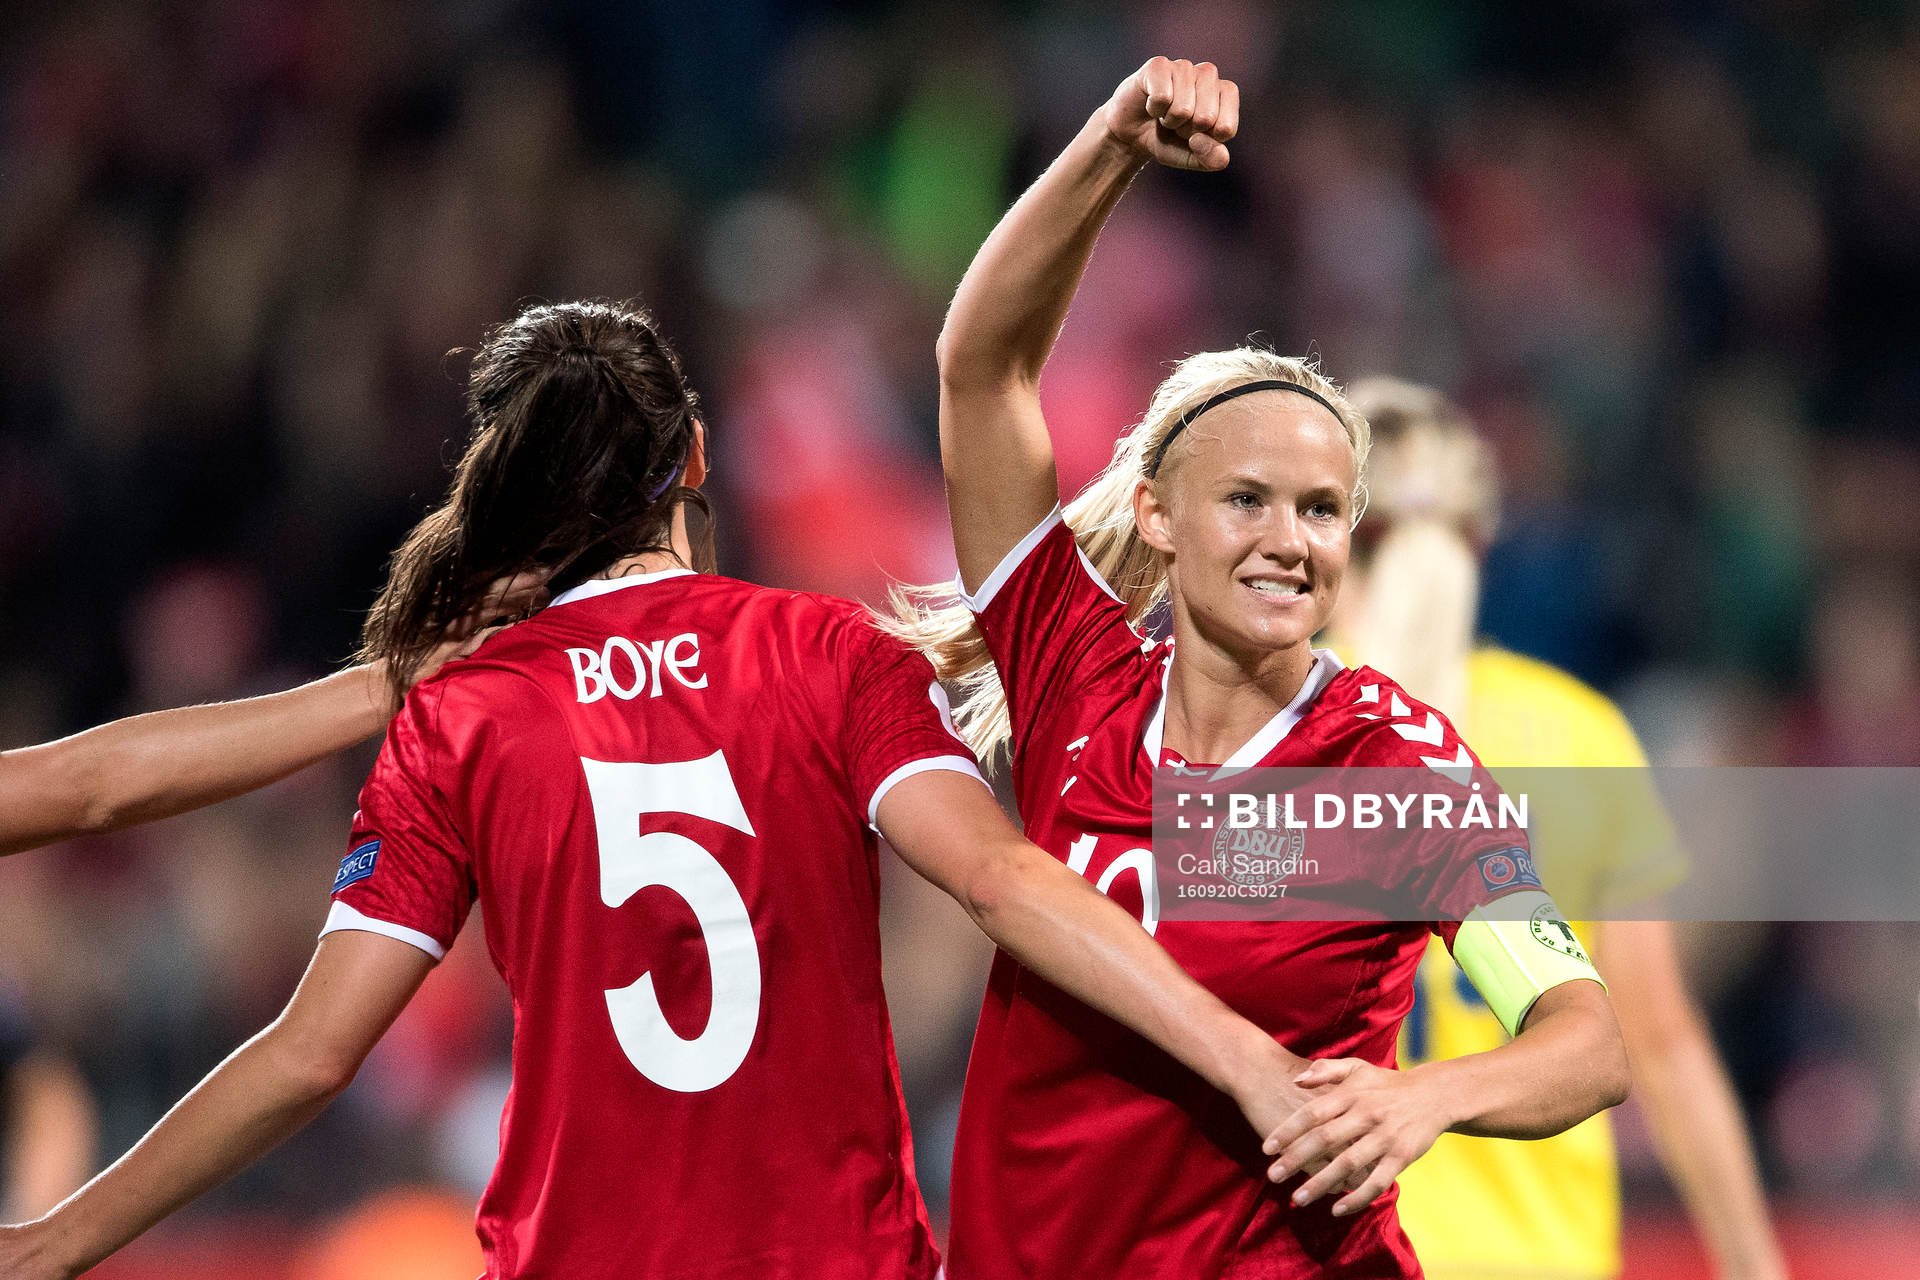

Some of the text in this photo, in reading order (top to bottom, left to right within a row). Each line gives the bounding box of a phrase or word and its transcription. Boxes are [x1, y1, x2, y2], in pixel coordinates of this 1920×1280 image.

[1230, 828, 1287, 859] DBU
[334, 850, 378, 884] ESPECT
[1229, 869, 1266, 885] 1889
[580, 748, 762, 1093] 5
